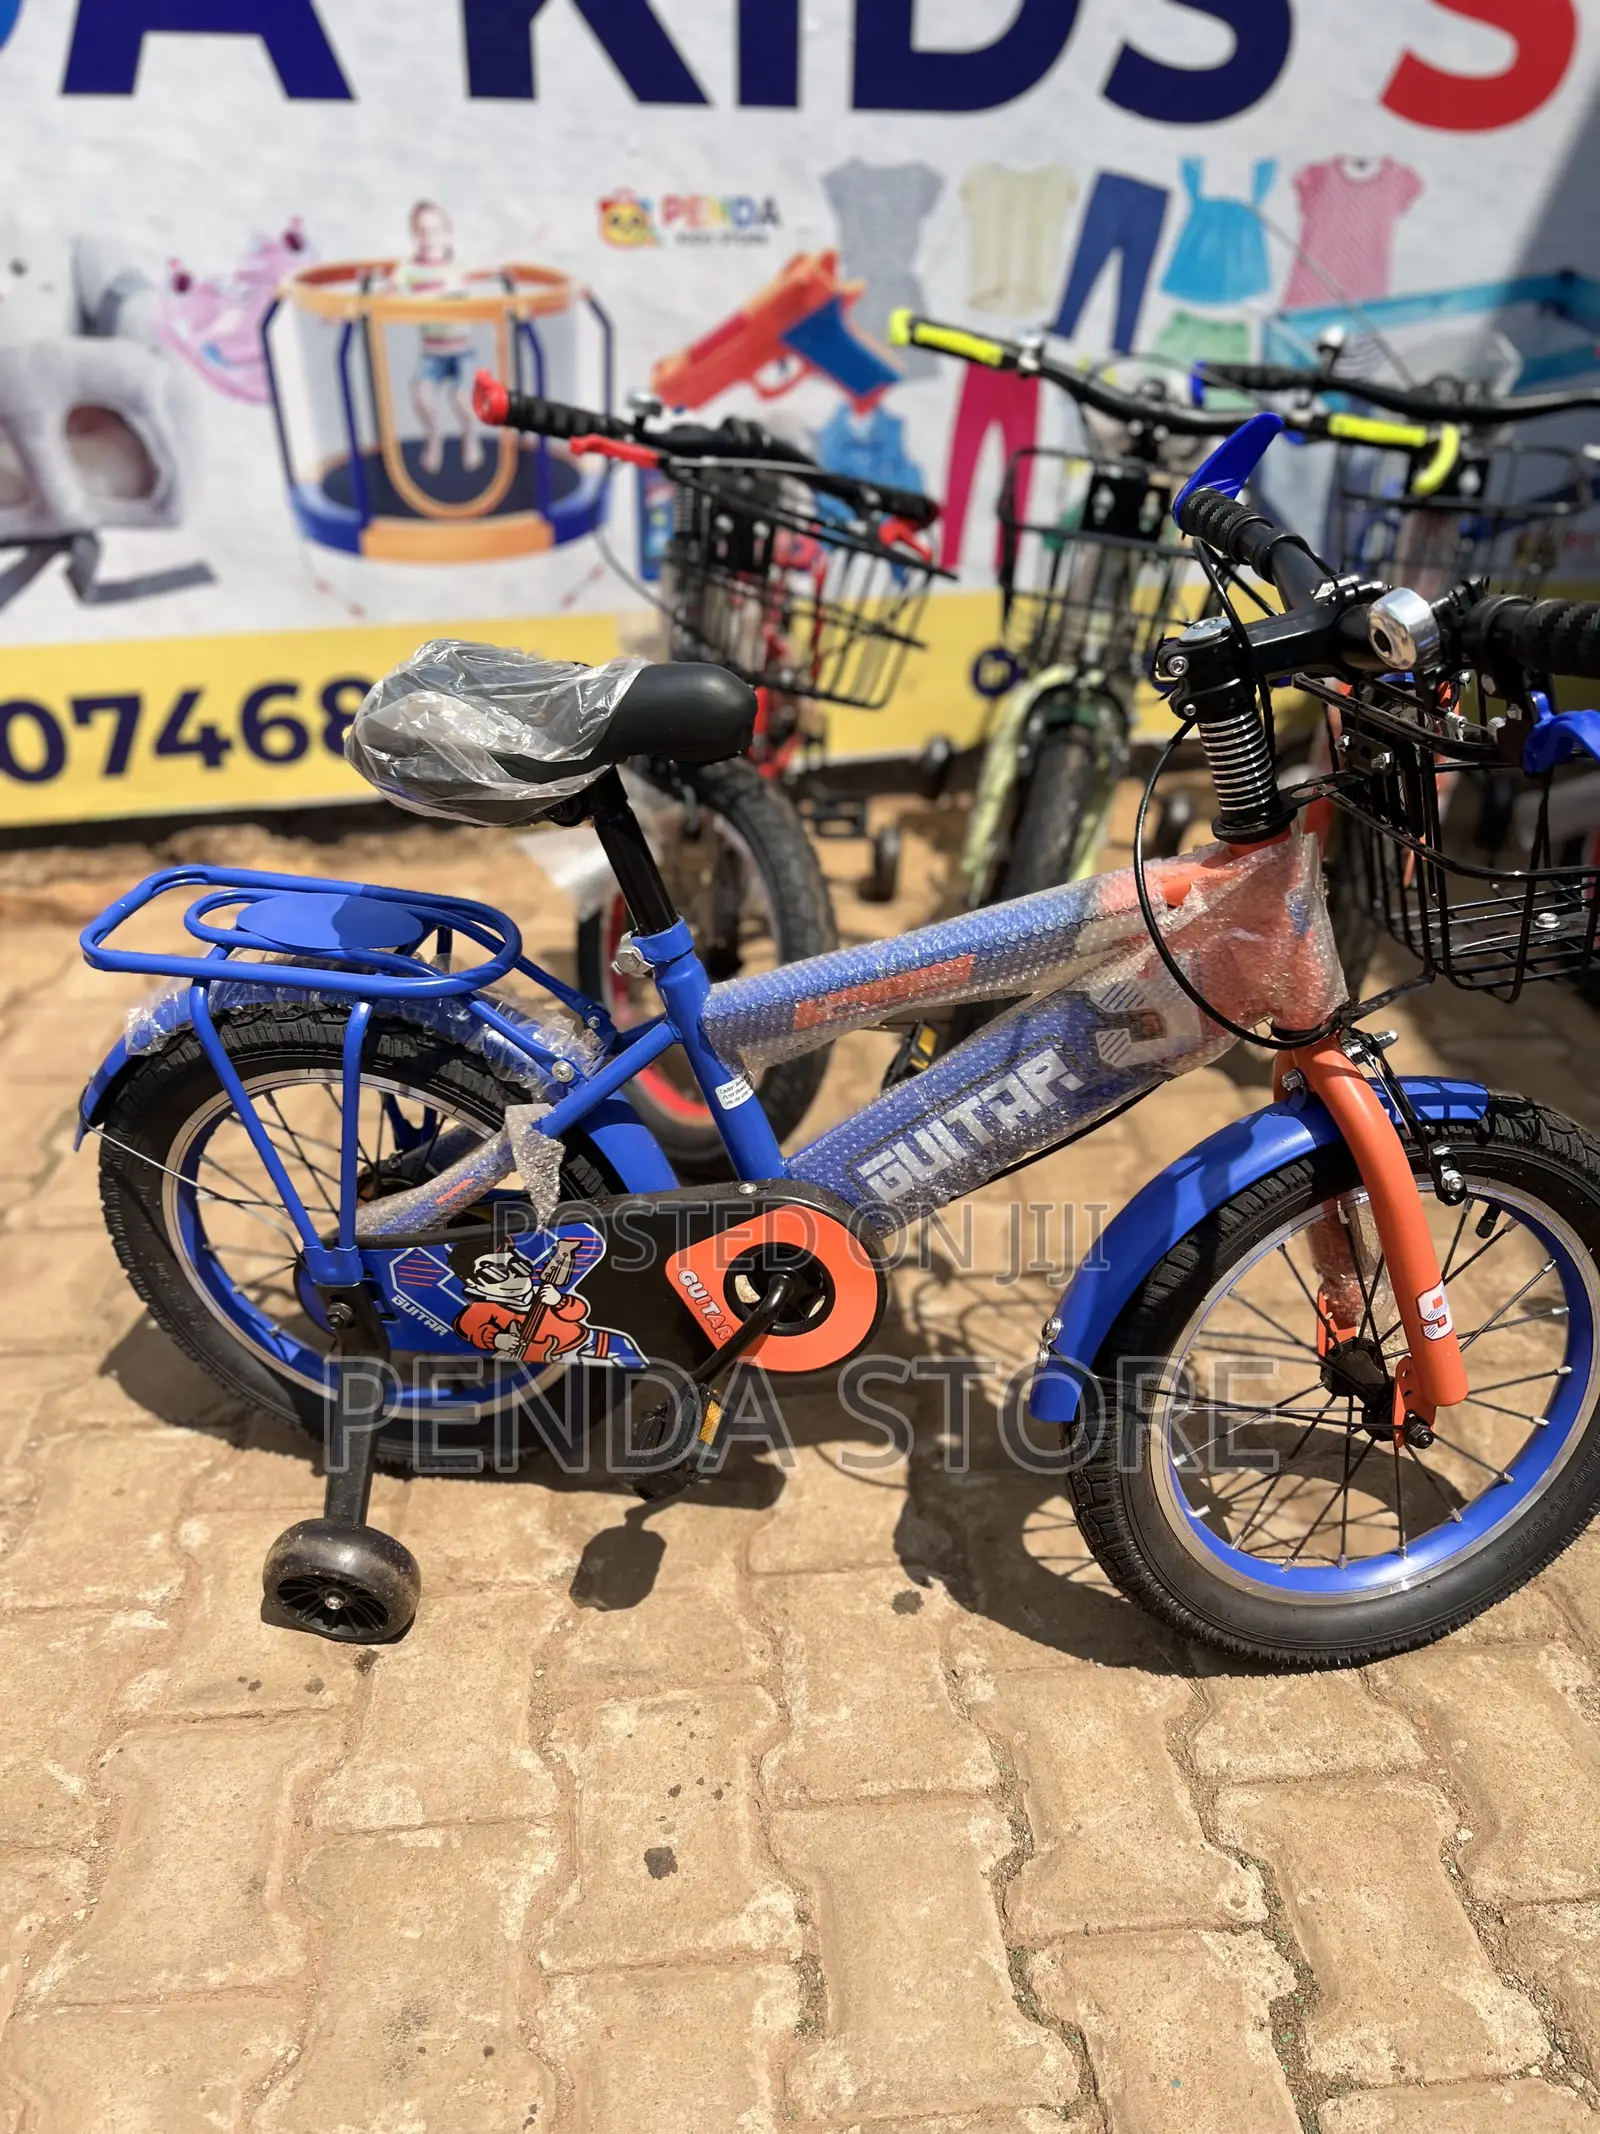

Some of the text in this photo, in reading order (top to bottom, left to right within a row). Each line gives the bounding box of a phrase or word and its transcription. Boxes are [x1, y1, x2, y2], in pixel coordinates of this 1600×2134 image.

[857, 1048, 1085, 1200] GUITAR
[390, 1294, 450, 1337] GUITAR
[678, 1268, 736, 1341] GUITAR
